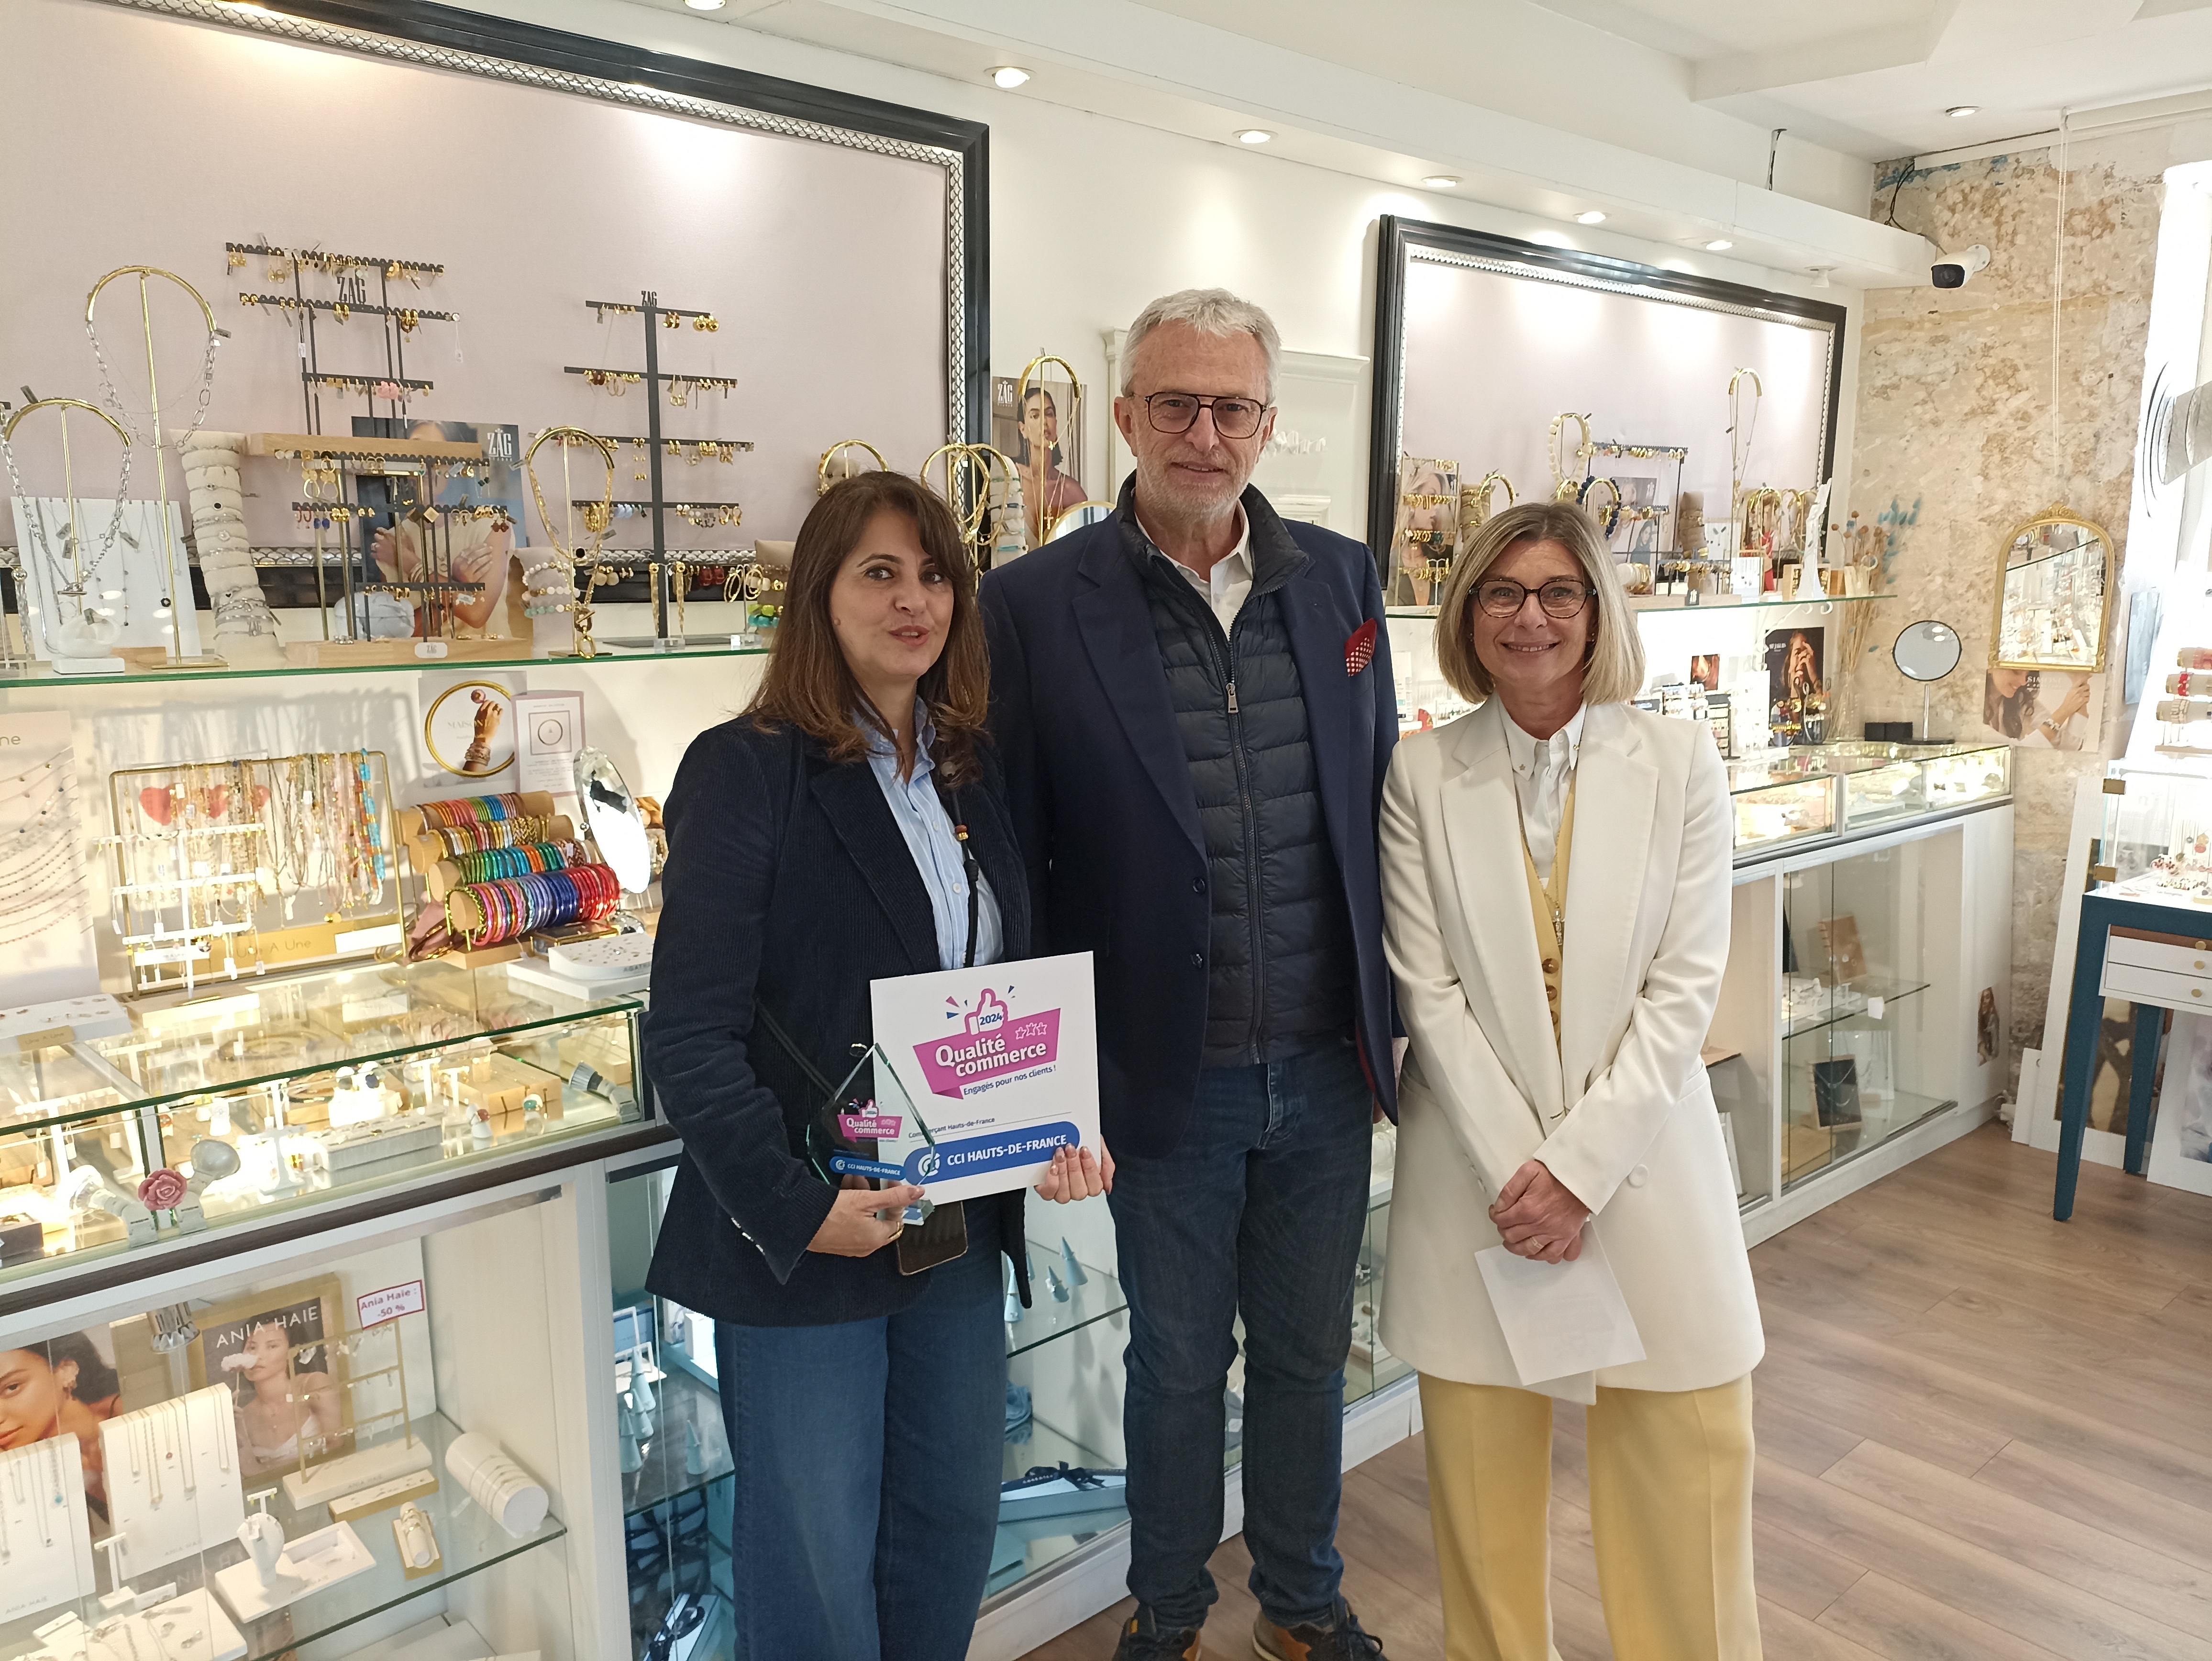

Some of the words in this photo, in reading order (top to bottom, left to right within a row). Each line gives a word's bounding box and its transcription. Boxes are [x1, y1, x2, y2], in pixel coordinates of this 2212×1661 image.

[336, 277, 366, 303] ZAG
[641, 290, 657, 306] ZAG
[997, 384, 1013, 403] ZAG
[487, 432, 512, 457] ZAG
[285, 939, 311, 951] Une
[979, 1013, 1003, 1026] 2024
[935, 1033, 1006, 1067] Qualité
[956, 1043, 1047, 1077] commerce
[963, 1081, 994, 1096] Engagés
[995, 1077, 1013, 1088] pour
[1029, 1067, 1053, 1077] clients
[846, 1118, 877, 1128] Qualité
[948, 1117, 995, 1129] Hauts-de-France
[947, 1153, 965, 1166] CCI
[967, 1134, 1067, 1163] HAUTS-DE-FRANCE
[856, 1164, 901, 1176] HAUTS-DE-FRANCE
[361, 1297, 384, 1310] Ania
[377, 1307, 393, 1318] -50
[216, 1321, 265, 1349] ANIA
[274, 1306, 319, 1330] HAIE
